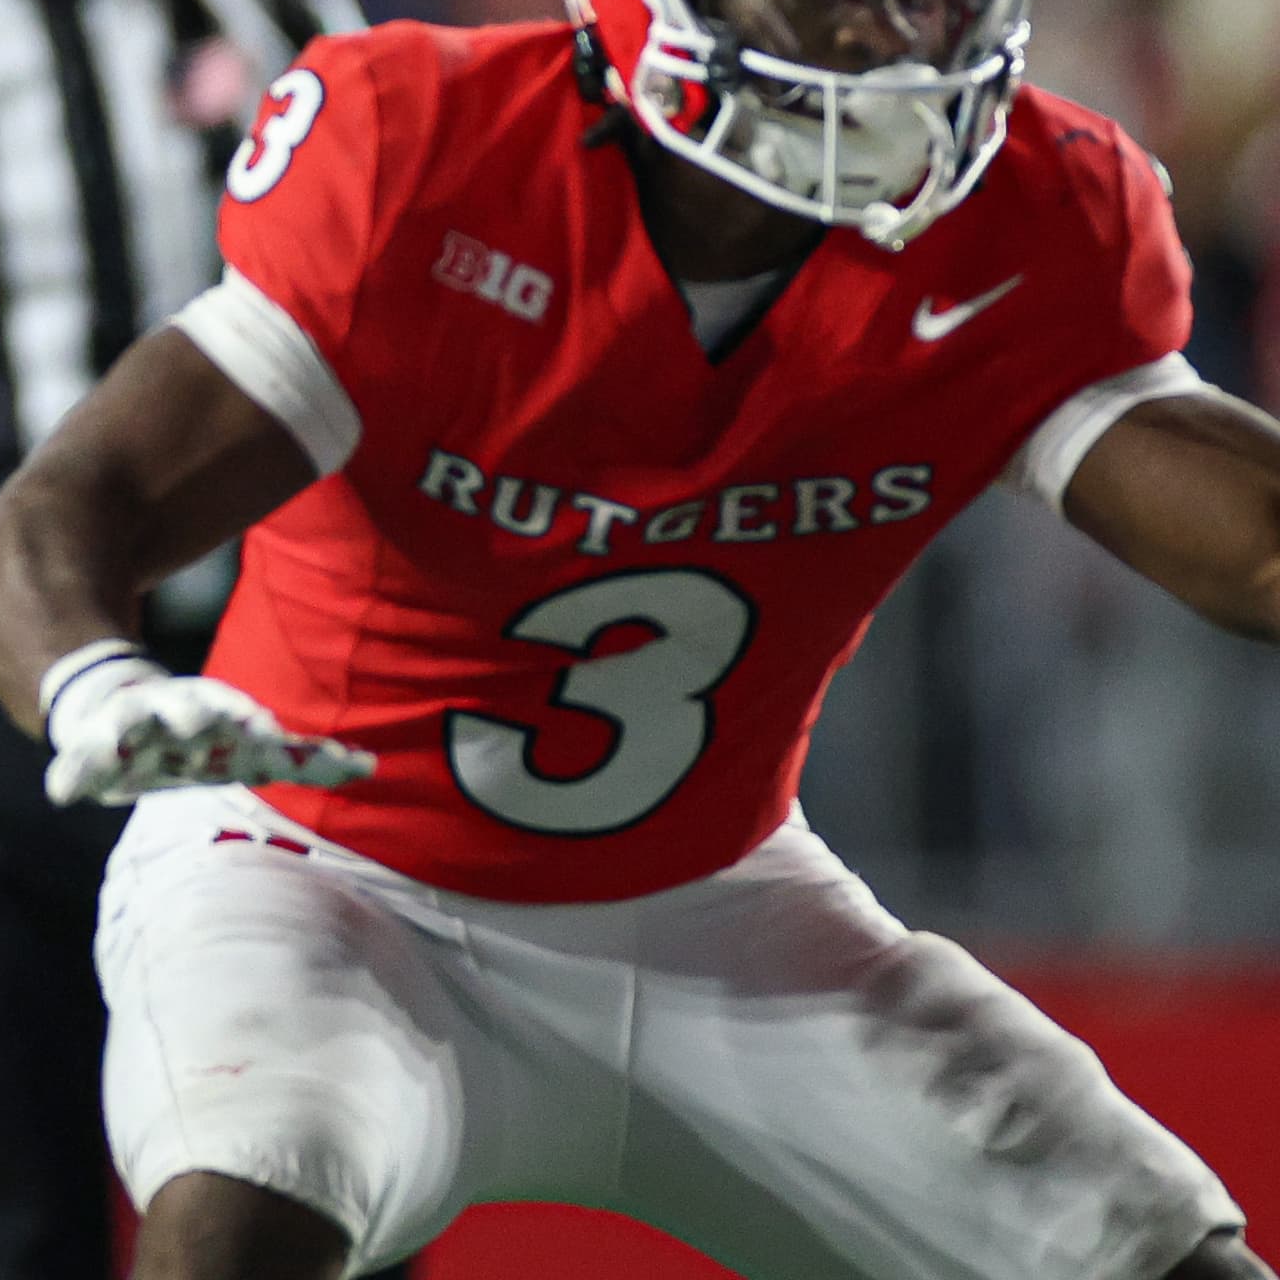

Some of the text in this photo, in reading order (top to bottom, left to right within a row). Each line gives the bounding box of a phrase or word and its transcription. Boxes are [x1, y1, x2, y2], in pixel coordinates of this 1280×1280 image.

[226, 68, 327, 204] 3
[432, 228, 556, 326] BIG
[417, 446, 934, 556] RUTGERS
[444, 566, 758, 838] 3
